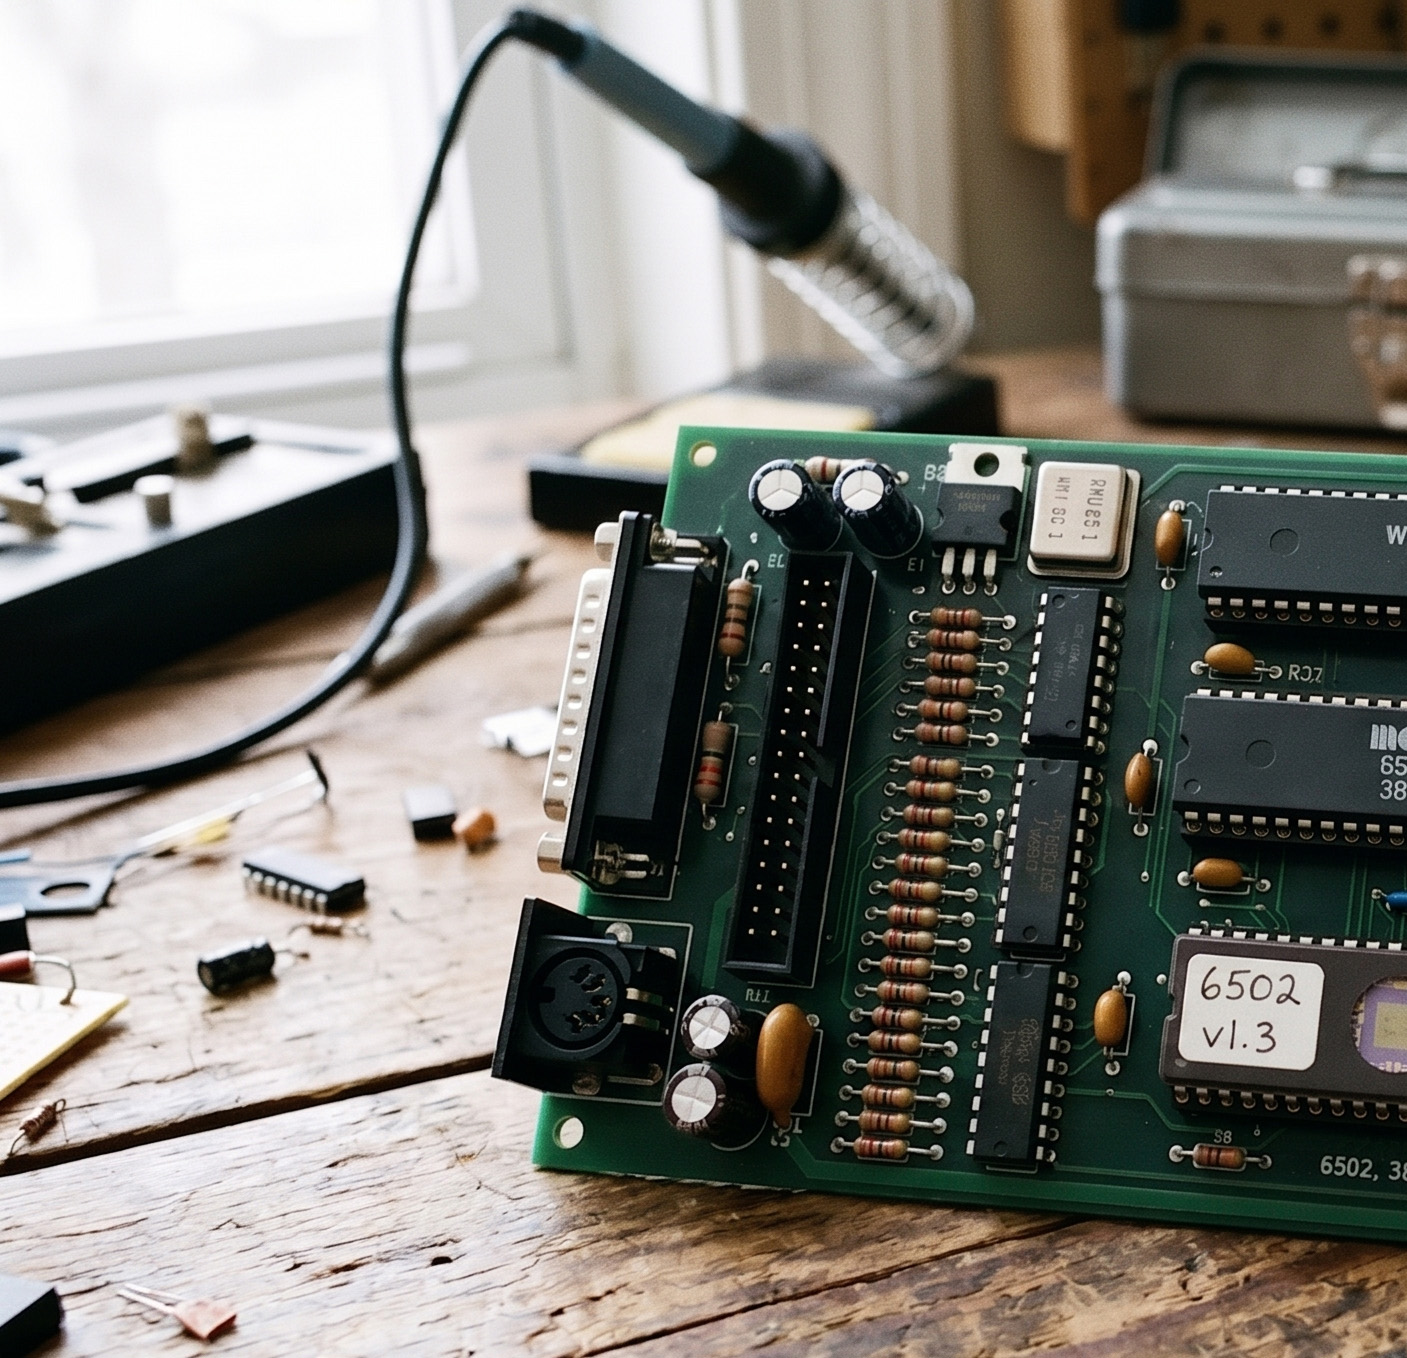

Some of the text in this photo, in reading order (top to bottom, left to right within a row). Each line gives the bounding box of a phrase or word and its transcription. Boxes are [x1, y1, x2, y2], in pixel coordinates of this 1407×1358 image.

[1200, 966, 1302, 1006] 6502
[1202, 1021, 1277, 1054] v1.3
[1320, 1155, 1378, 1181] 6502,
